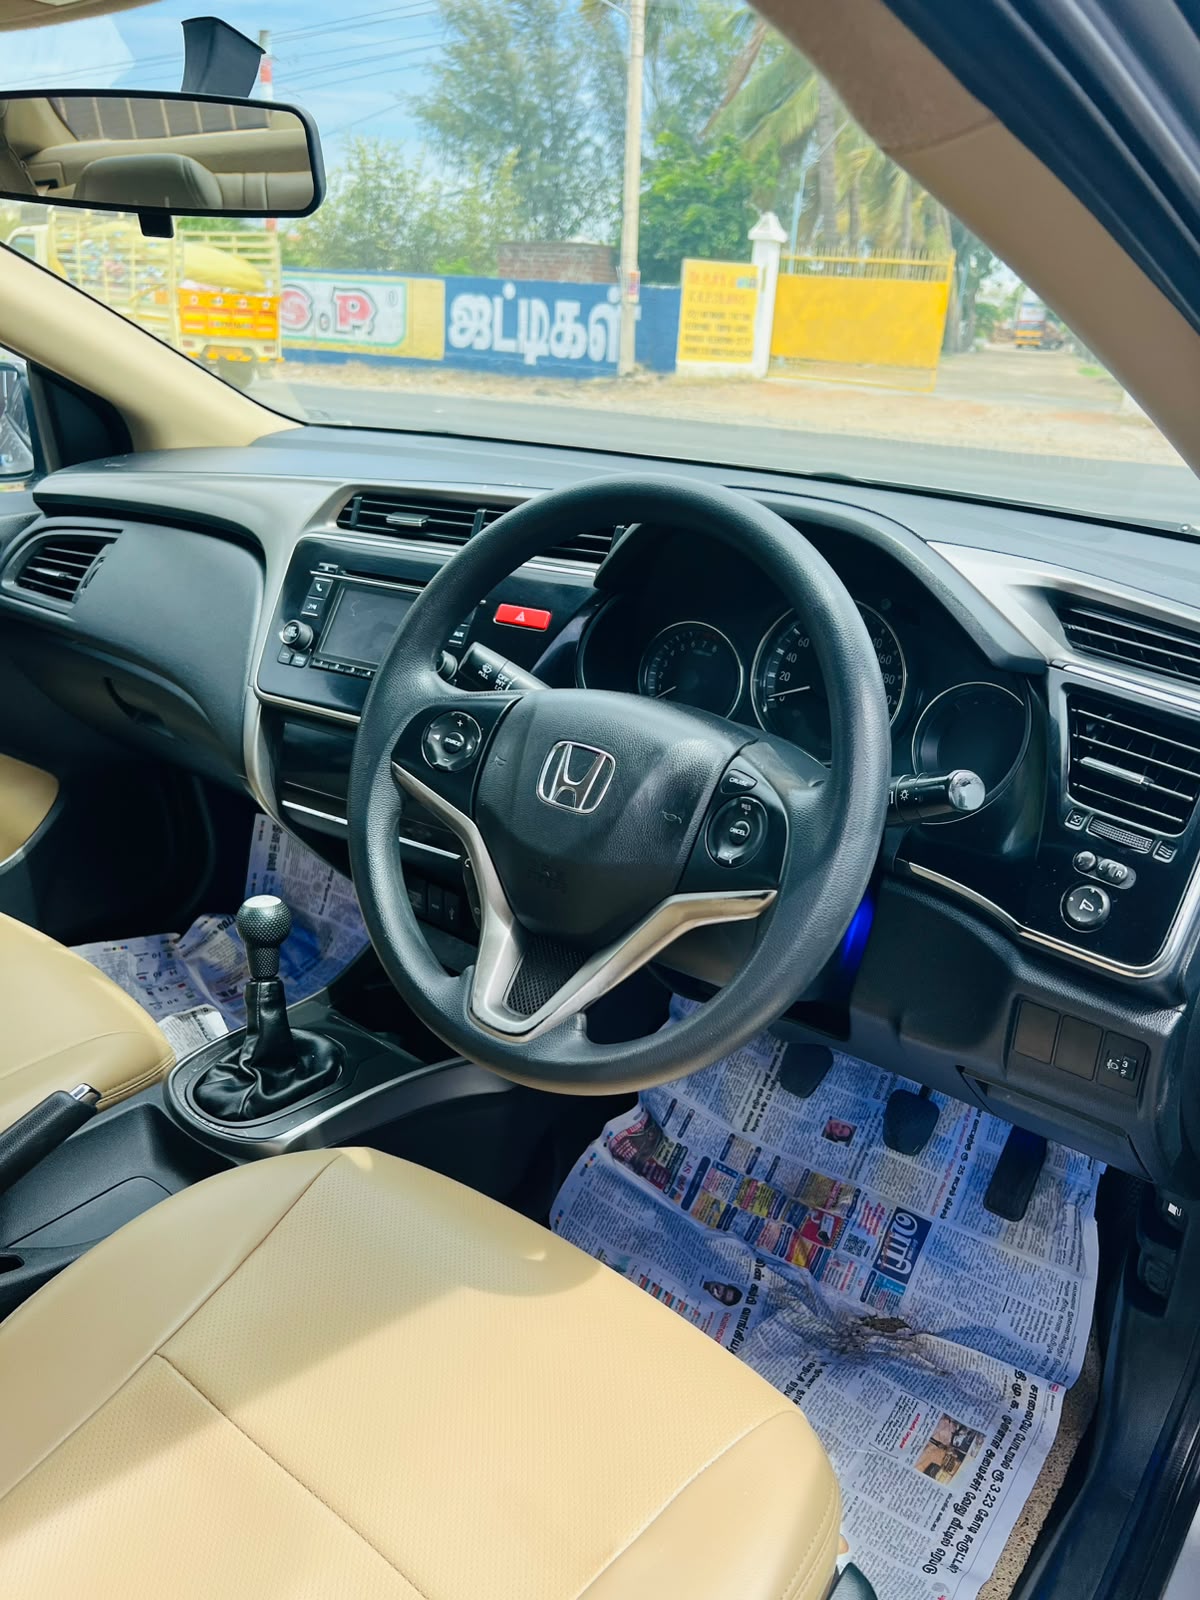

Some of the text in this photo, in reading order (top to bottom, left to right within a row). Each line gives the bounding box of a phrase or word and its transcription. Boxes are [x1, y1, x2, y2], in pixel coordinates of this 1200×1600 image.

[786, 652, 798, 663] 40
[797, 637, 810, 647] 60
[779, 670, 791, 681] 20
[956, 1164, 965, 1175] 25
[1017, 1383, 1041, 1434] சாலையே
[989, 1413, 1015, 1450] முன்னாள்
[999, 1431, 1025, 1471] போடாமல்
[968, 1447, 998, 1493] அமைச்சர்
[951, 1489, 975, 1517] வேலு
[981, 1468, 1005, 1509] ரூ.3.23
[939, 1515, 964, 1549] வீட்டில்
[966, 1506, 989, 1536] கோடி
